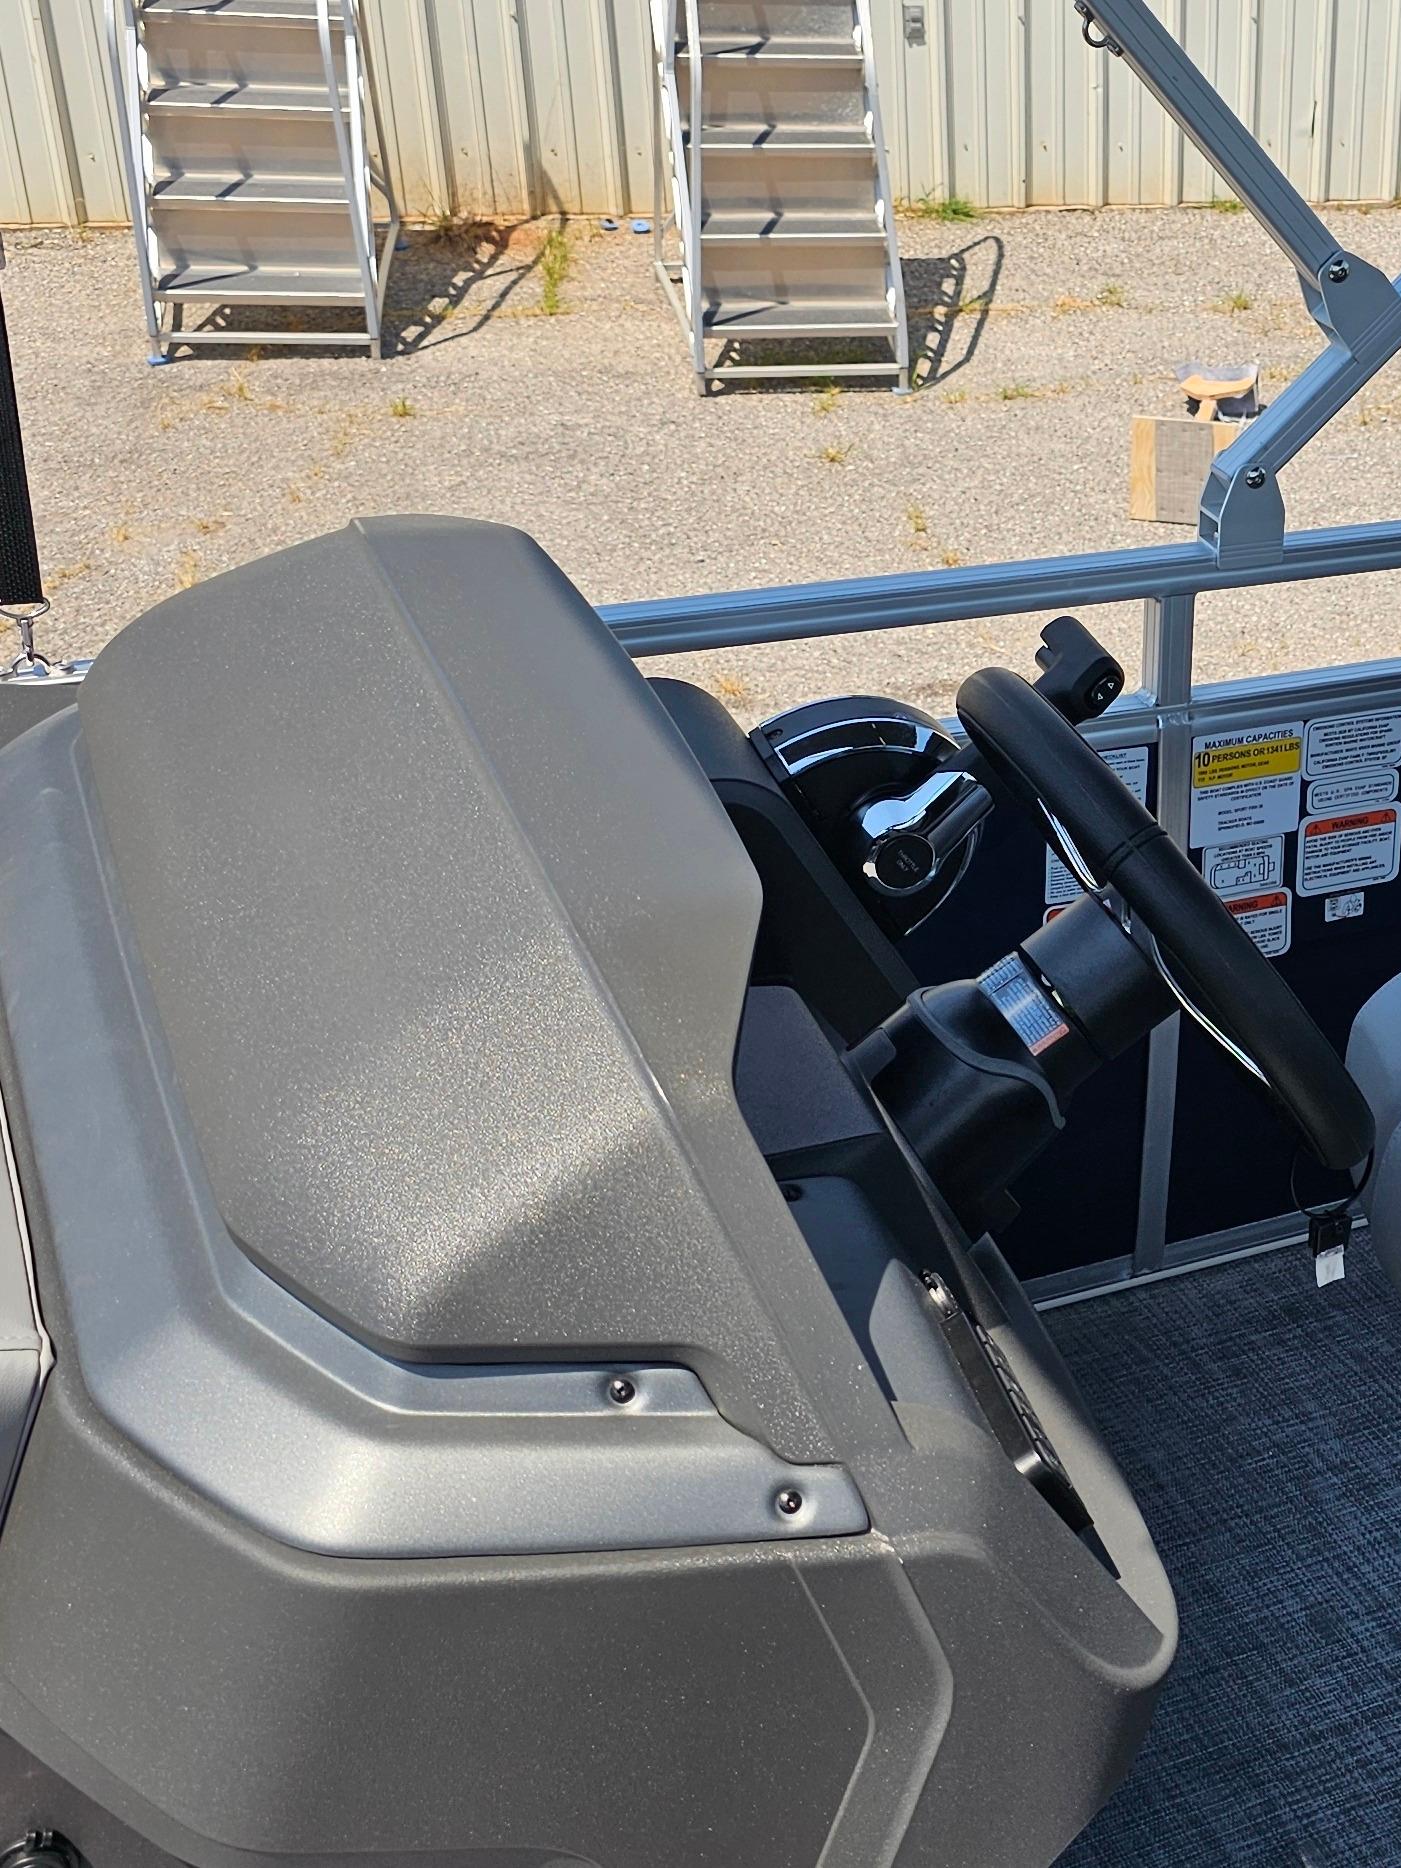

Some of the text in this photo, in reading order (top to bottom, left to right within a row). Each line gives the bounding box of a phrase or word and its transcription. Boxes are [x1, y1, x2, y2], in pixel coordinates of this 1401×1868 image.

[1204, 729, 1294, 749] MAXIMUM CAPACITIES
[1195, 752, 1210, 768] 10
[1212, 749, 1251, 763] PERSONS
[1252, 748, 1265, 757] OR
[1284, 742, 1300, 752] LBS
[1331, 816, 1369, 829] WARNING
[1227, 901, 1258, 912] ARNING
